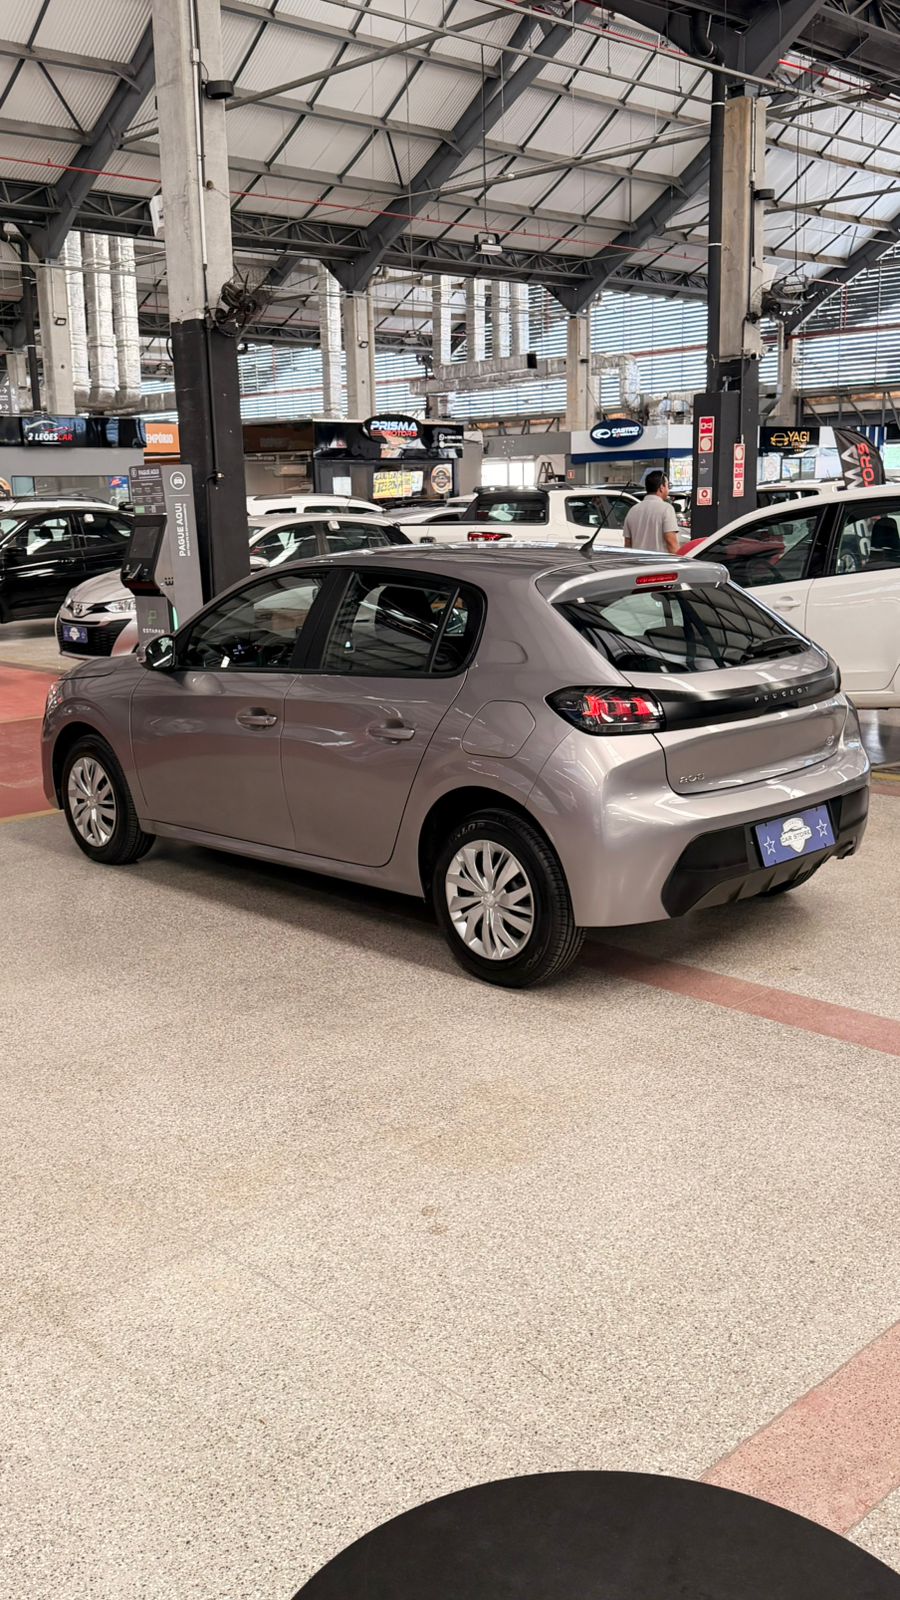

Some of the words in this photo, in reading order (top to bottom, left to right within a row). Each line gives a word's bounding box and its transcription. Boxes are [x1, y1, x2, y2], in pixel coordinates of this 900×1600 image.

[370, 421, 418, 431] PRISMA
[611, 426, 640, 434] CASTRO
[28, 432, 34, 441] 2
[787, 430, 810, 442] YAGI
[174, 502, 184, 526] AQUI
[176, 526, 187, 557] PAGUE
[754, 686, 809, 703] PEUGEOT
